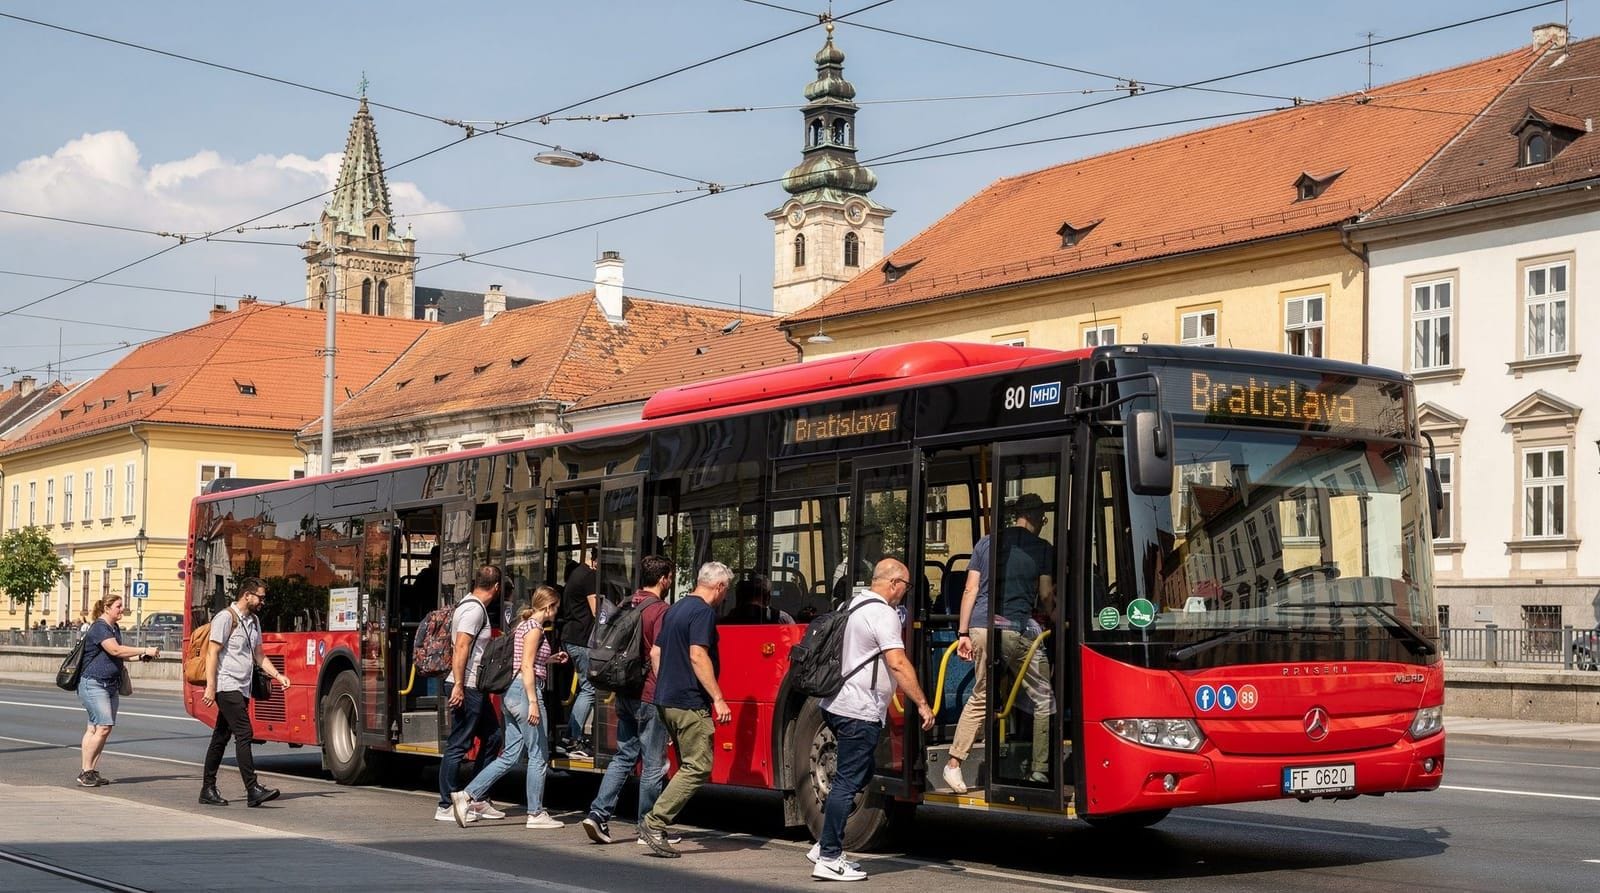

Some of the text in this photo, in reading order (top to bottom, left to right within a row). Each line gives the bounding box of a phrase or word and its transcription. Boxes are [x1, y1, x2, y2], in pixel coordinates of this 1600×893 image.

[1004, 385, 1026, 410] 80
[1033, 387, 1058, 404] MHD
[1191, 371, 1355, 423] Bratislava
[1292, 767, 1347, 788] FF G620
